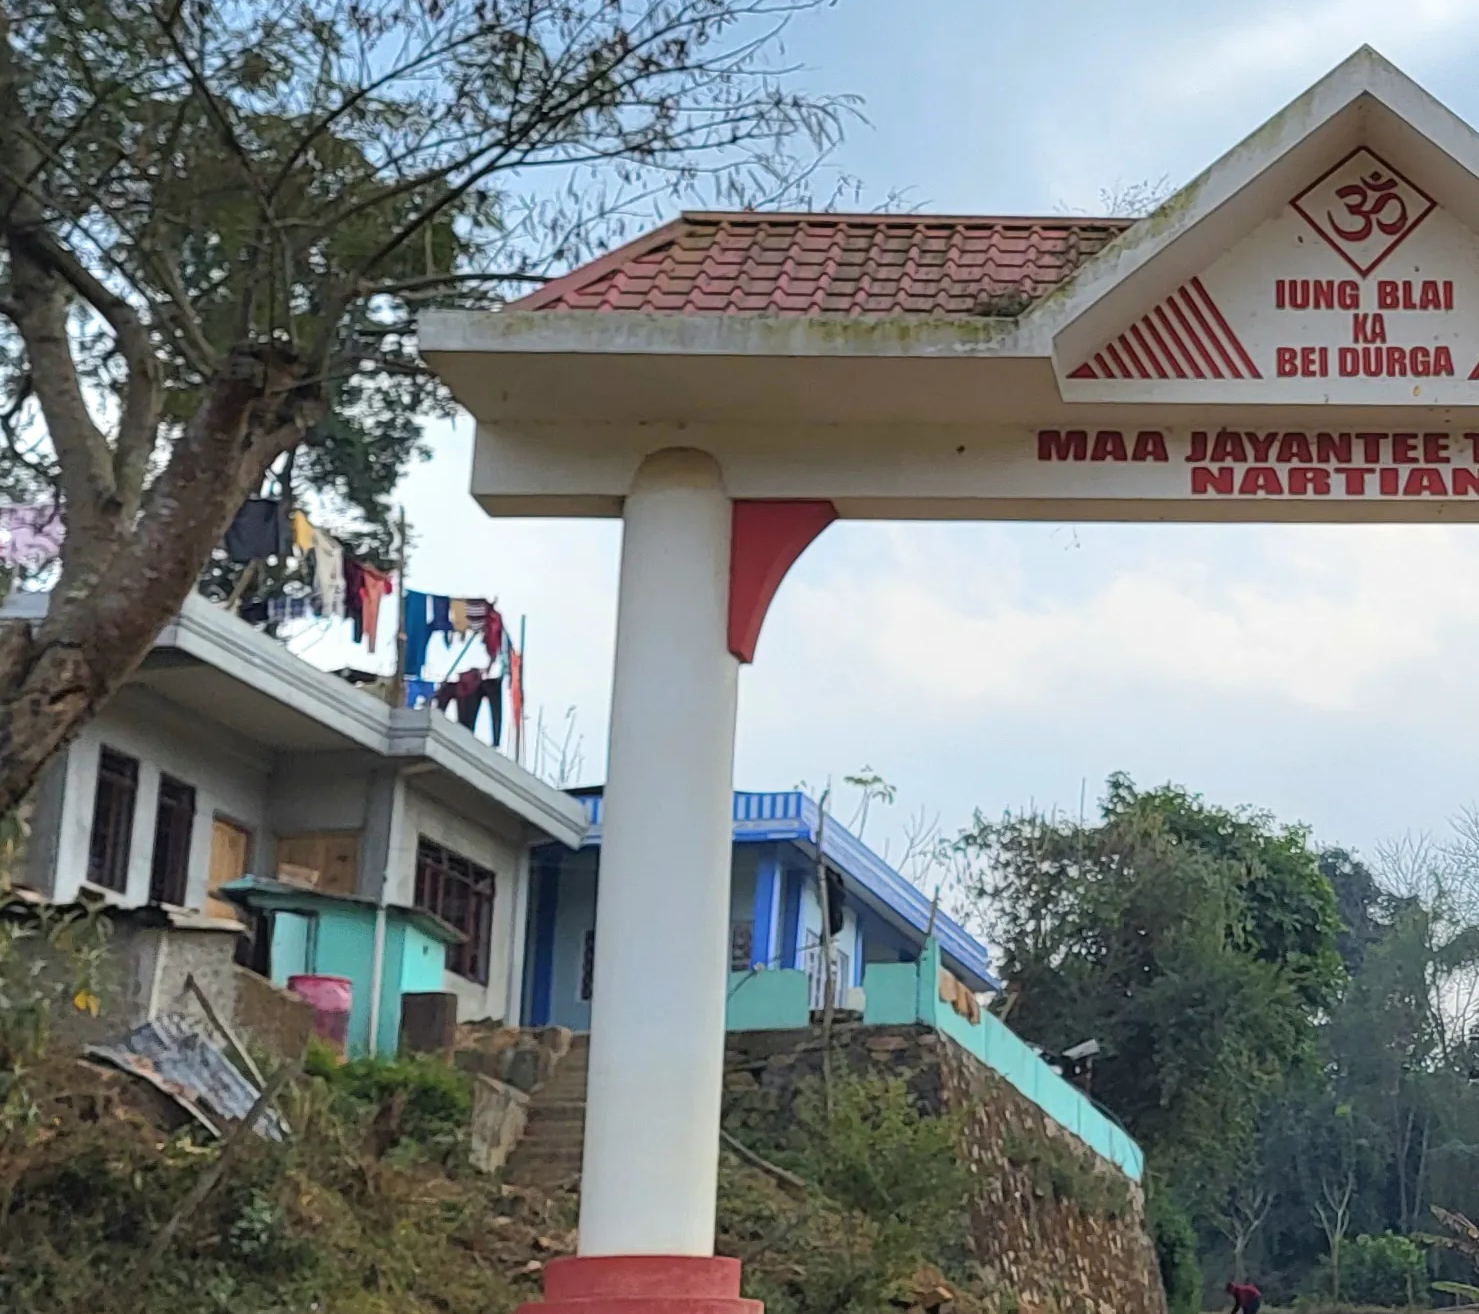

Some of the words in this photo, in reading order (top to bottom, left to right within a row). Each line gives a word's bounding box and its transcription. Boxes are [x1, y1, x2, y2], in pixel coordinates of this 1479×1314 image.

[1275, 279, 1360, 310] IUNG
[1377, 280, 1454, 310] BLAI
[1353, 312, 1387, 344] KA
[1276, 346, 1329, 377] BEI
[1338, 346, 1455, 377] DURGA
[1037, 430, 1169, 462] MAA
[1185, 431, 1451, 464] JAYANTEE
